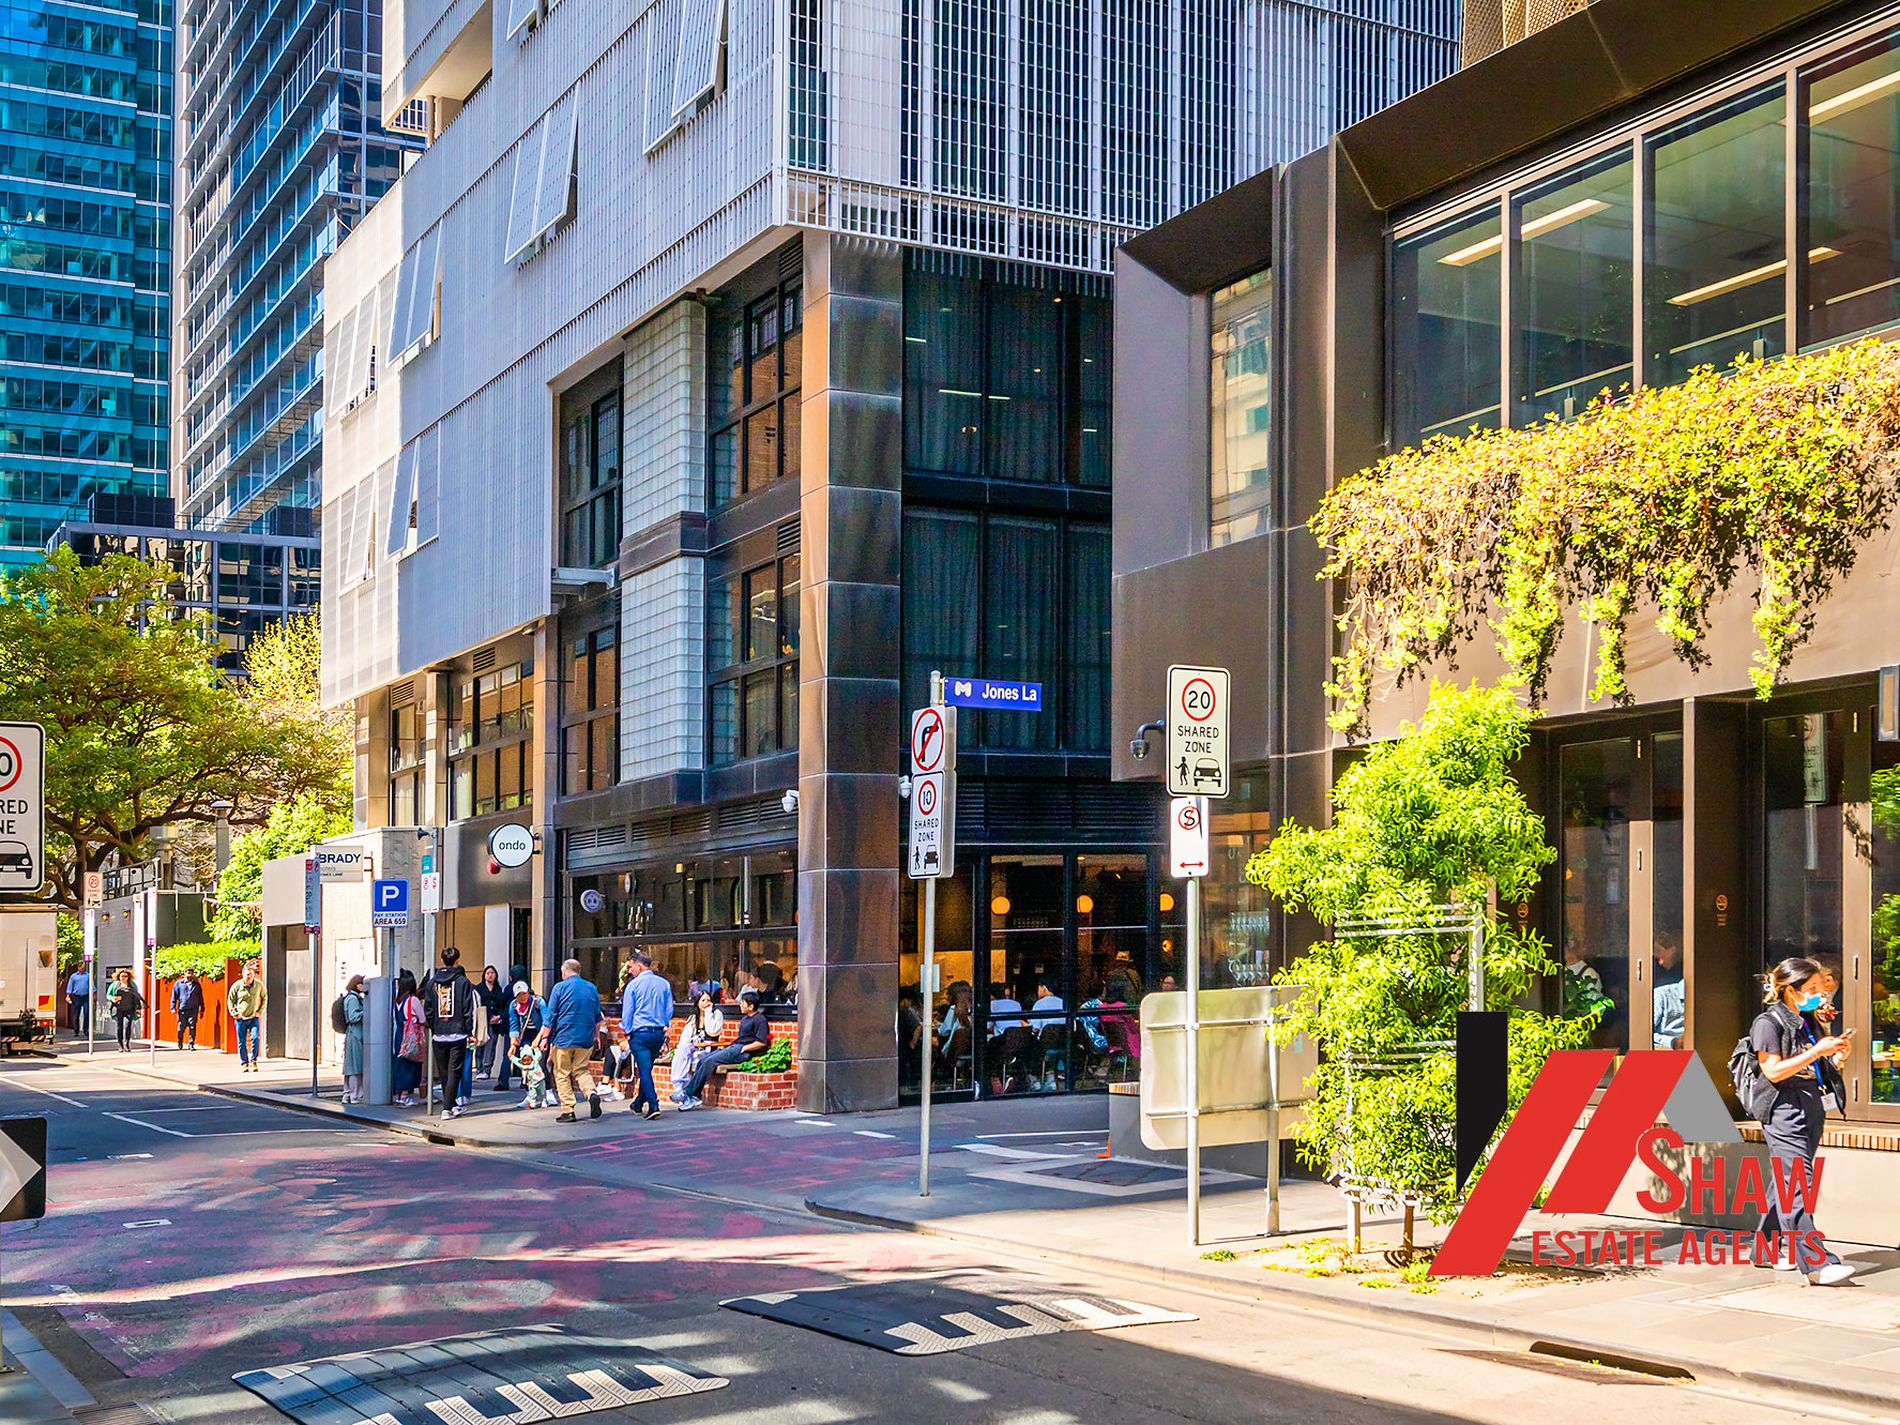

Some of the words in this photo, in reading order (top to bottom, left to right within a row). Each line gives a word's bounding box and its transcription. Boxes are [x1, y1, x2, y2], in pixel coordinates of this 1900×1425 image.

[982, 683, 1019, 700] Jones
[1022, 685, 1037, 701] La
[1188, 690, 1211, 710] 20
[1177, 725, 1219, 739] SHARED
[1184, 741, 1212, 754] ZONE
[0, 752, 13, 776] 0
[923, 790, 932, 806] 10
[914, 818, 940, 831] SHARED
[917, 831, 935, 842] ZONE
[498, 840, 526, 851] ondo
[318, 853, 361, 863] BRADY
[382, 885, 400, 907] P
